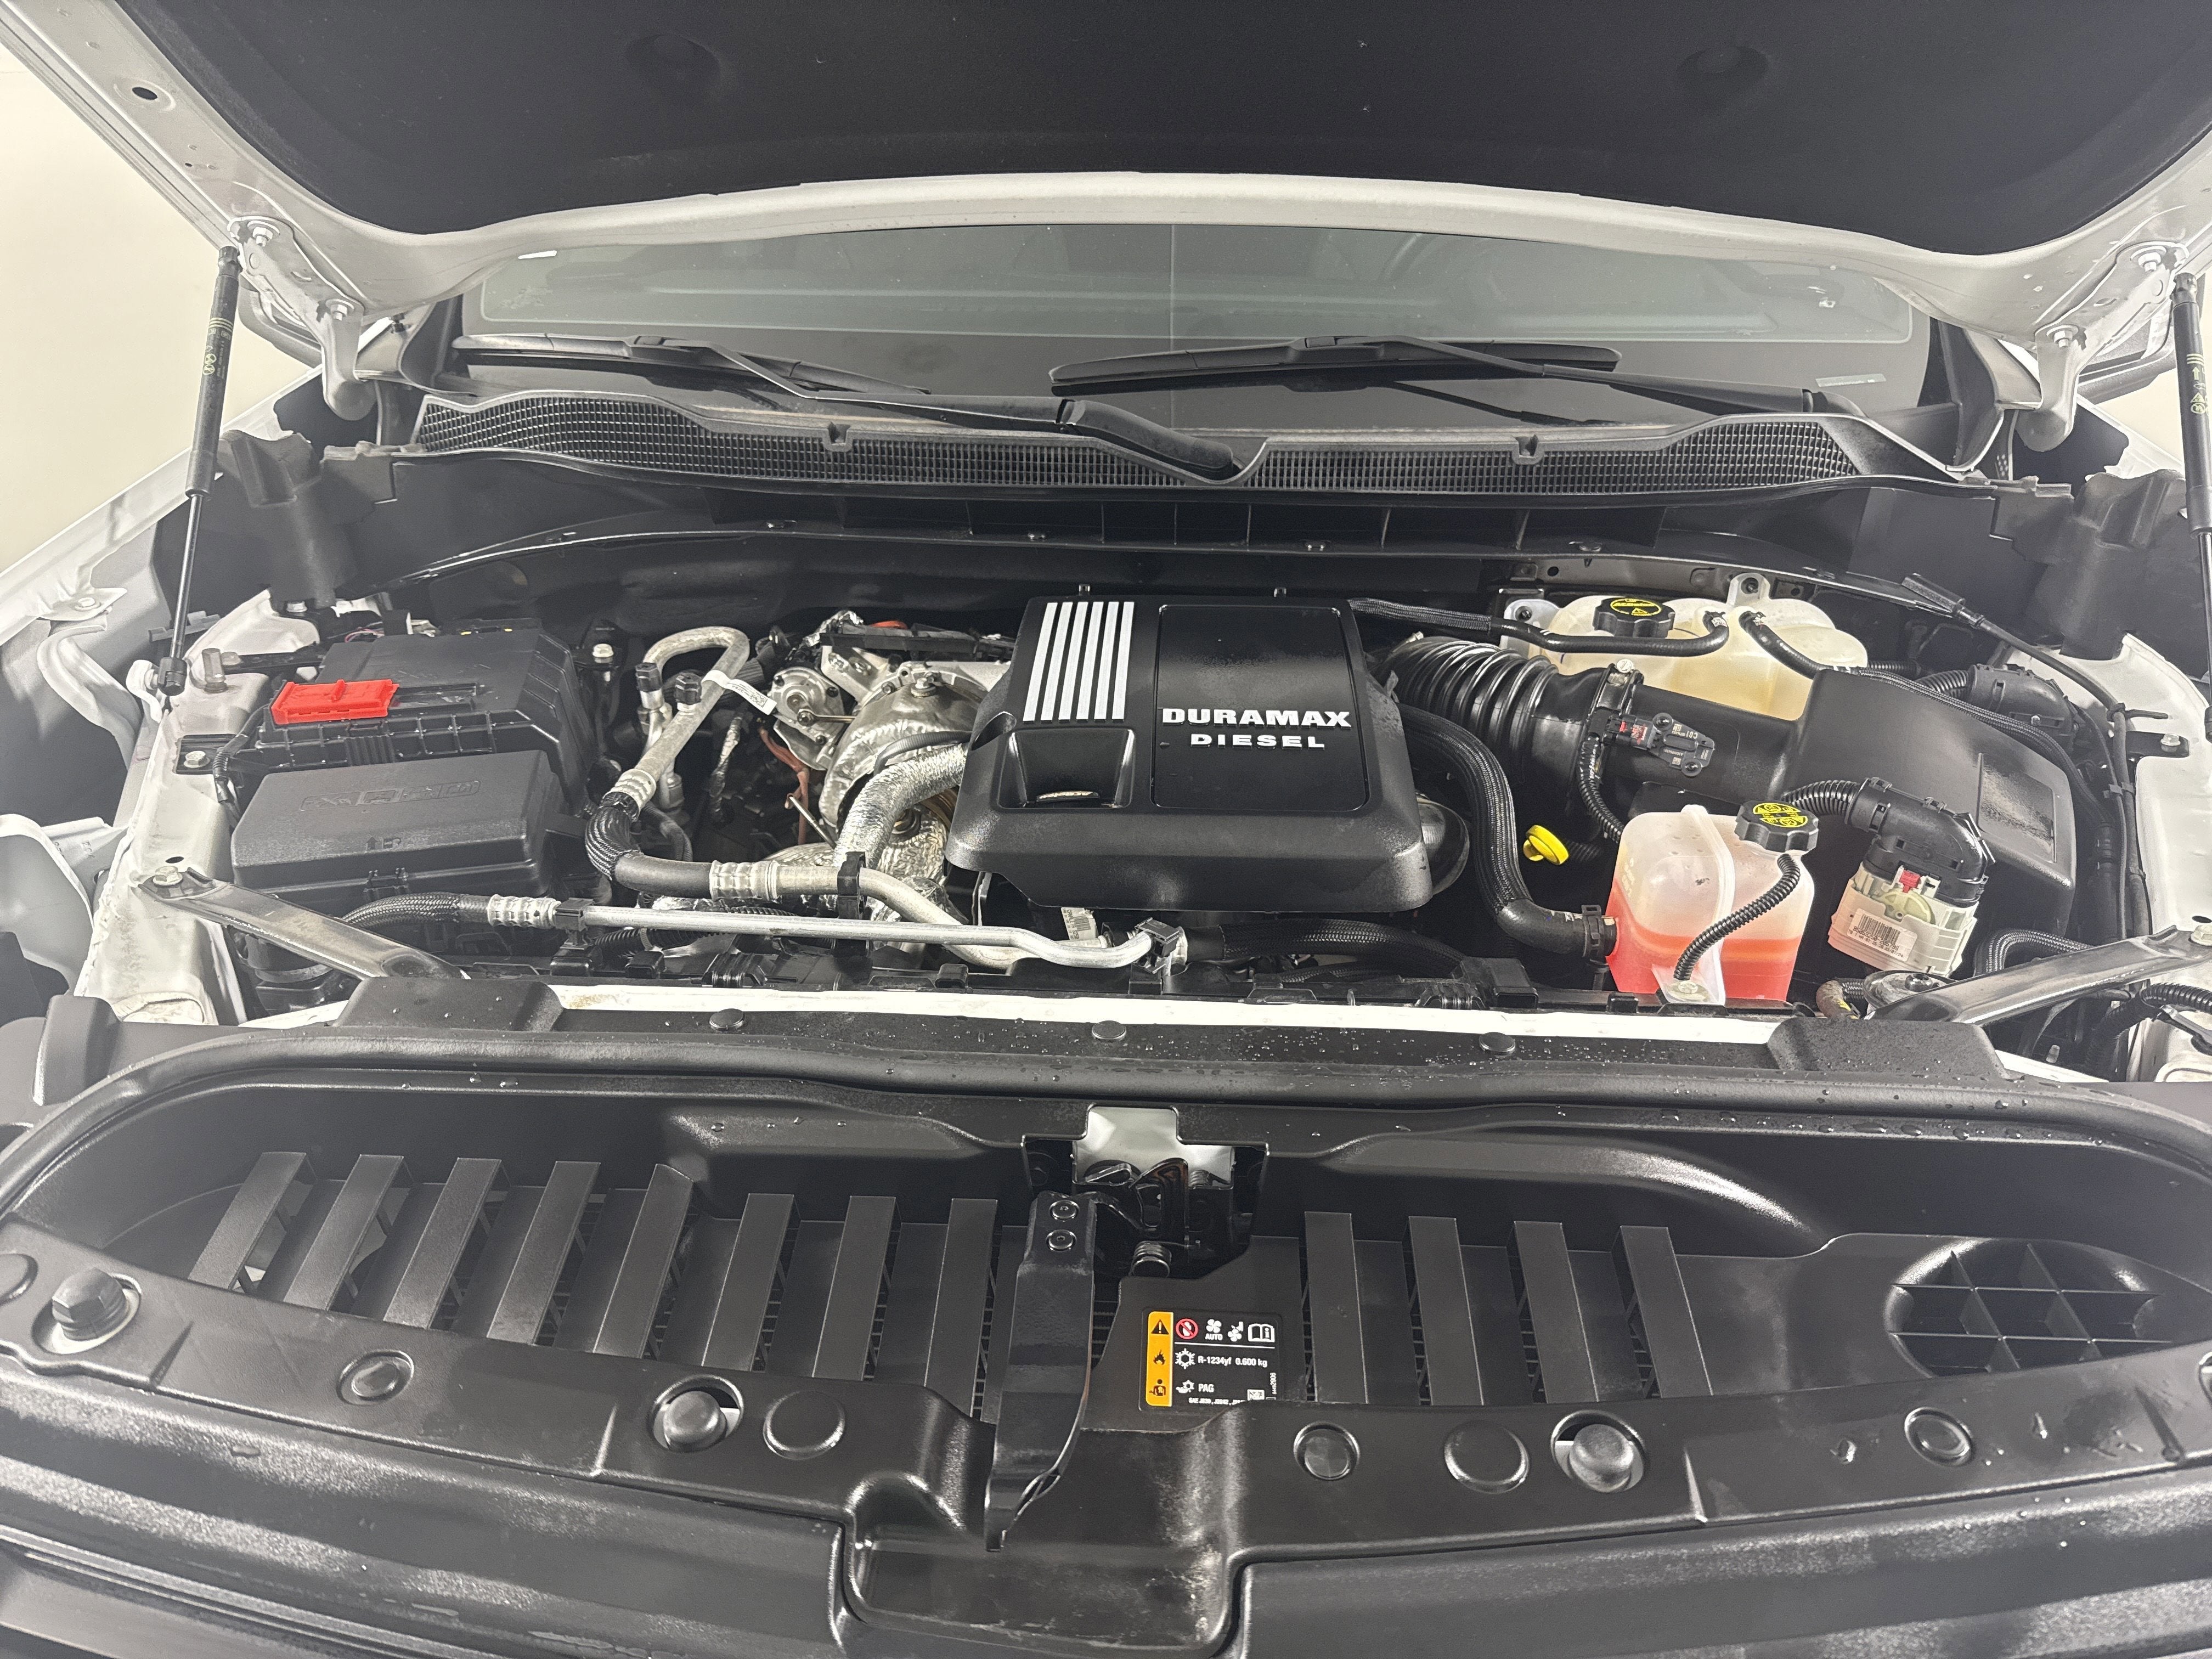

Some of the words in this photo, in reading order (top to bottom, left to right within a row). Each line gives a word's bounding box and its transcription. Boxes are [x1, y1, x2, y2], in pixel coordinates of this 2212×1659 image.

[1163, 708, 1351, 728] DURAMAX
[1190, 733, 1325, 749] DIESEL
[1198, 1356, 1232, 1366] R-1234yf
[1257, 1358, 1267, 1368] kg
[1198, 1384, 1214, 1392] PAG
